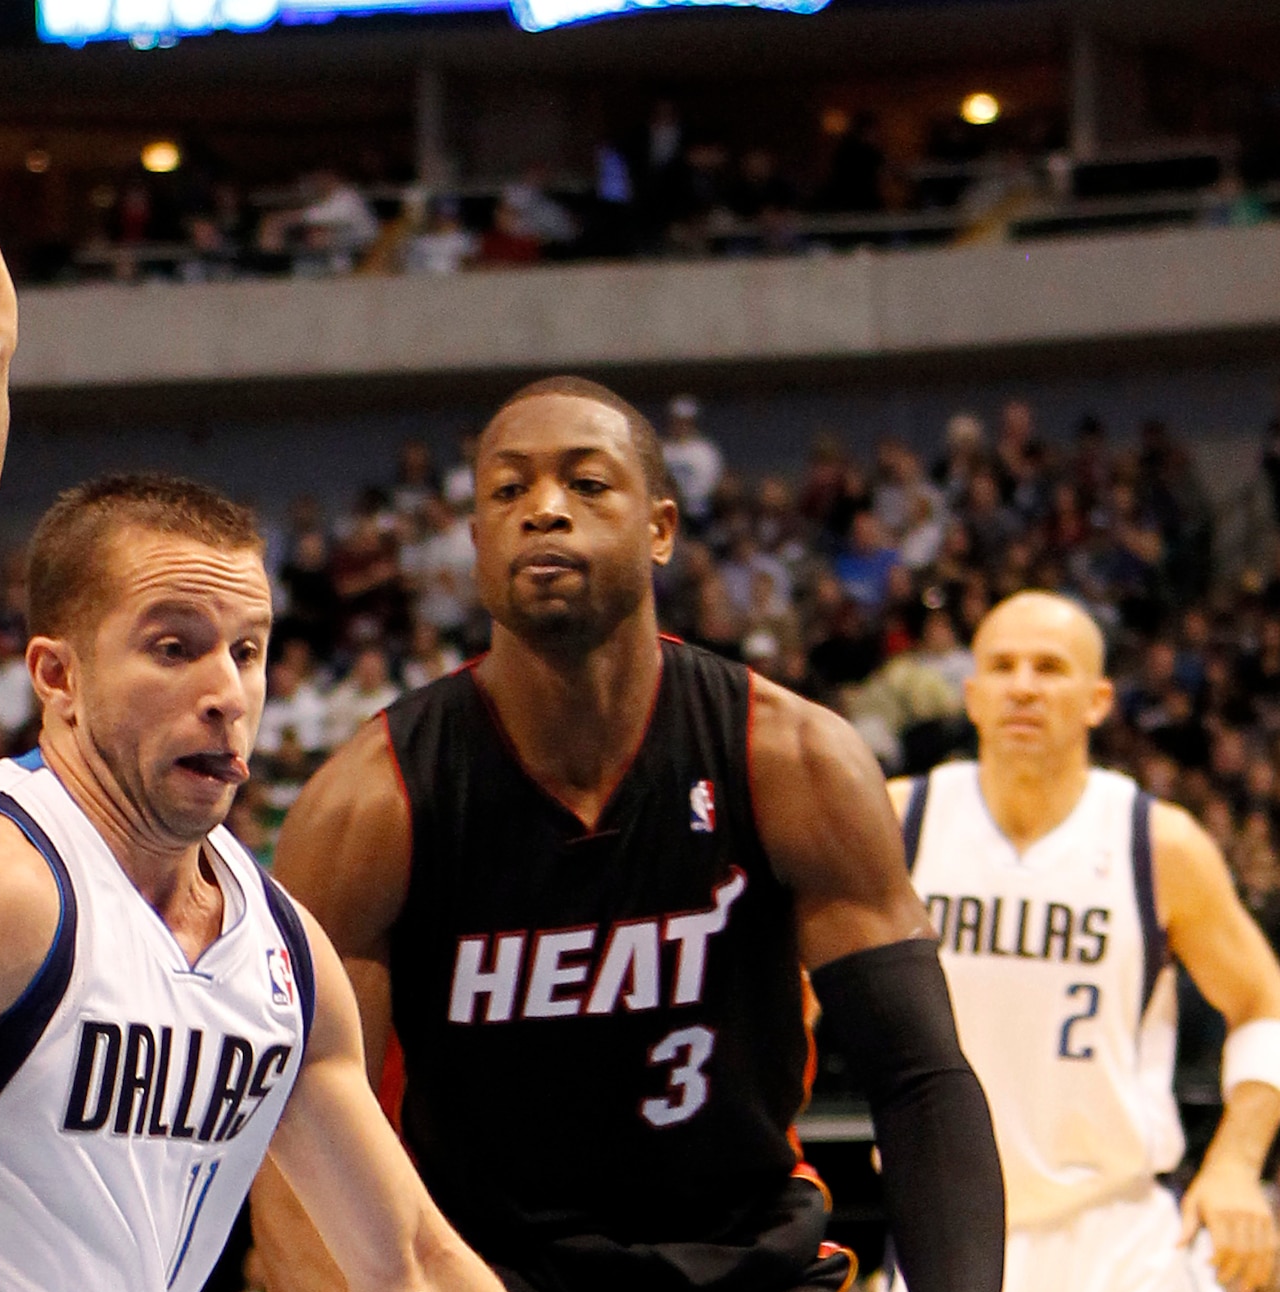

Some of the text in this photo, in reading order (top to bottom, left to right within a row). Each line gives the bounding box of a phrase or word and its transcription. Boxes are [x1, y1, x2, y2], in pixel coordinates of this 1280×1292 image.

[446, 865, 748, 1025] HEAT
[1057, 981, 1101, 1061] 2
[638, 1023, 717, 1130] 3
